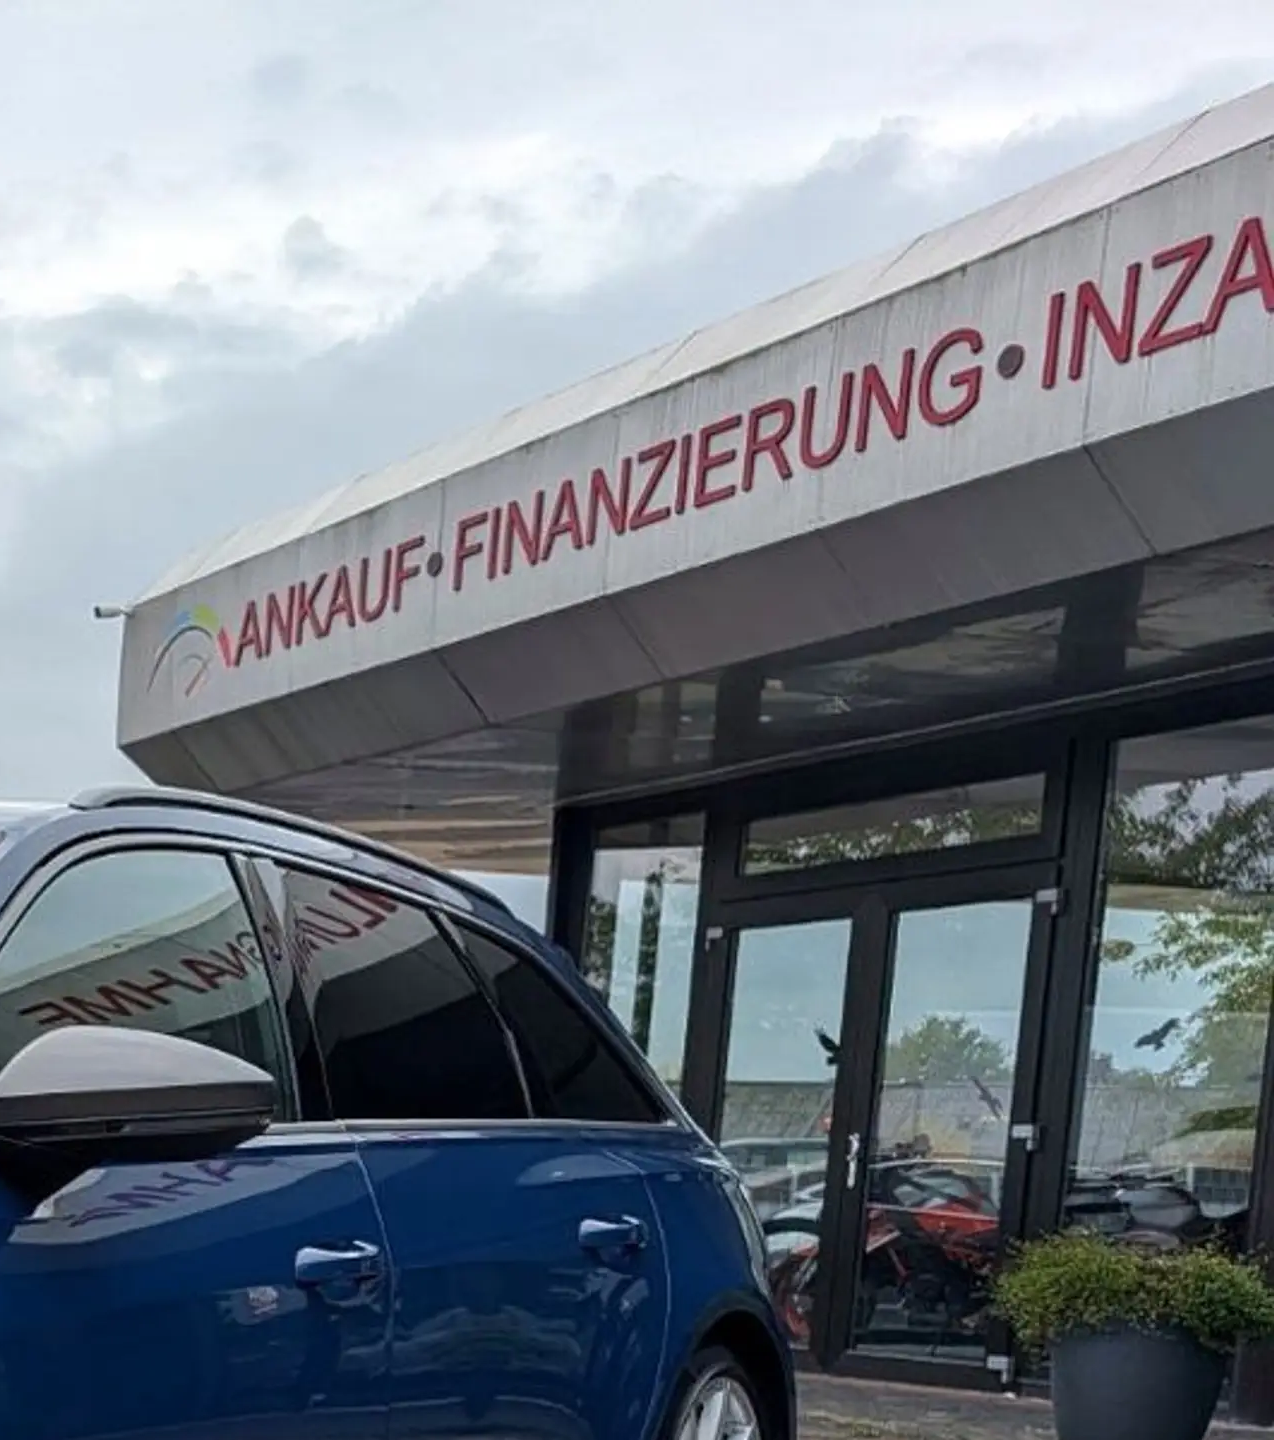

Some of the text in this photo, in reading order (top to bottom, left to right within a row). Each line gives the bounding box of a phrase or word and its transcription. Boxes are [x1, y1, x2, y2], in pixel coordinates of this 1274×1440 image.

[233, 216, 1274, 668] ANKAUF FINANZIERUNG INZA
